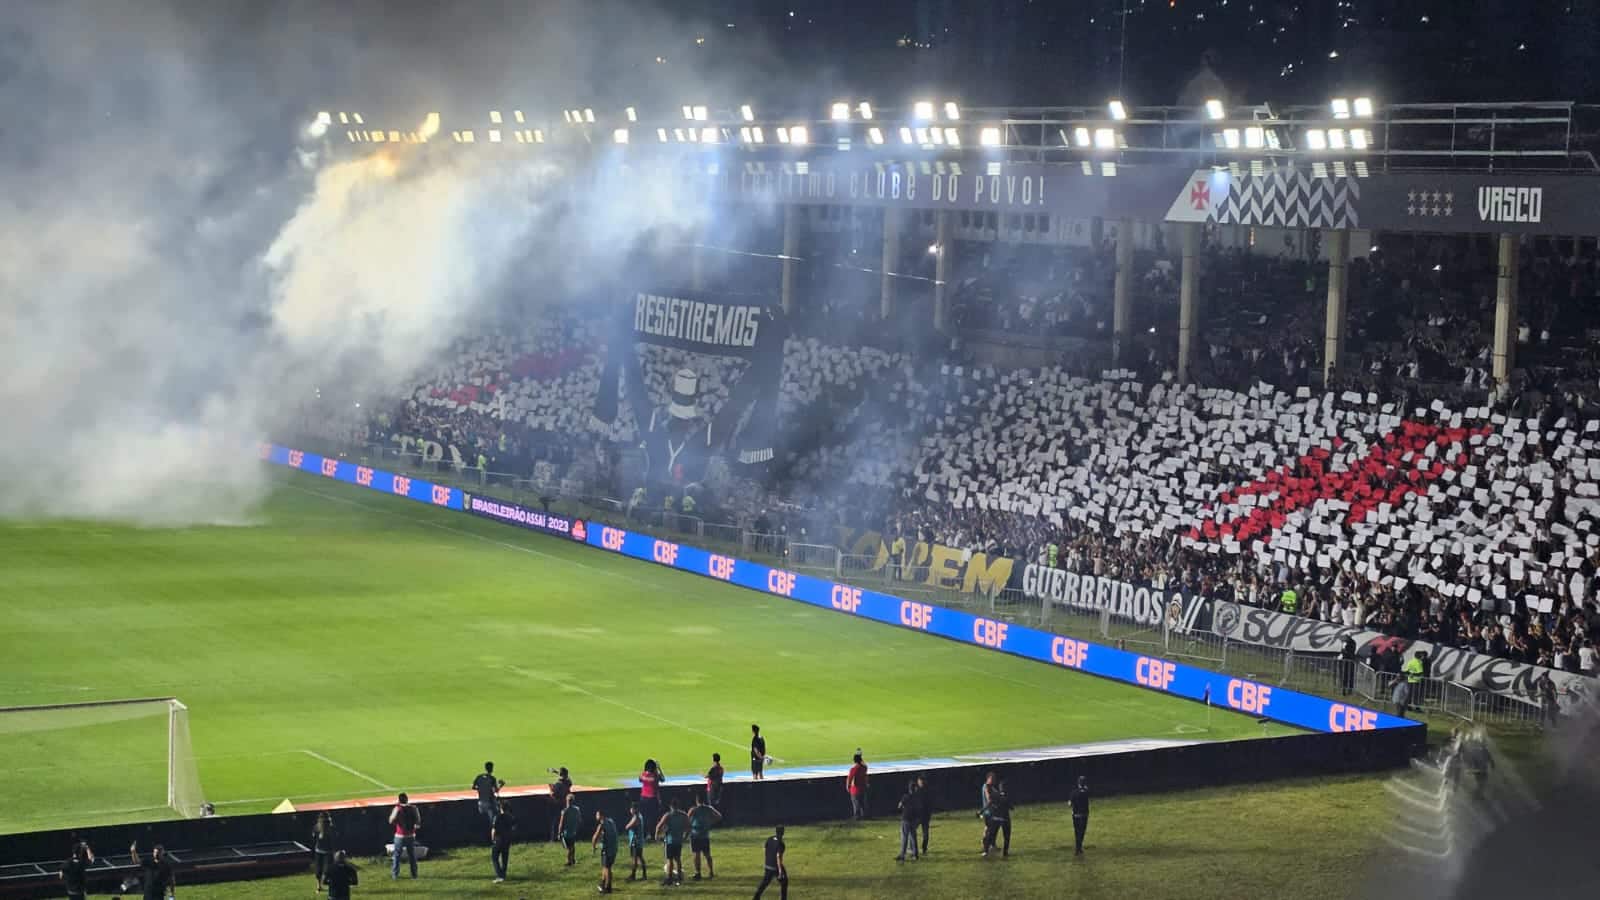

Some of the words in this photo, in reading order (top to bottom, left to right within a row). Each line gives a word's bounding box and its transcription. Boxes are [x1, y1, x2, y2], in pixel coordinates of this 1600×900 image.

[932, 173, 959, 203] DO
[973, 174, 1044, 206] POVO!
[1478, 187, 1542, 223] VASCO
[634, 292, 761, 347] RESISTIREMOS
[289, 449, 304, 469] CBF
[322, 457, 339, 478] CBF
[356, 466, 374, 487] CBF
[393, 475, 411, 497] CBF
[432, 485, 452, 507] CBF
[471, 498, 526, 523] BRASILEIRÃO
[548, 517, 569, 533] 2023
[834, 527, 1014, 597] OVEM
[1022, 563, 1164, 625] GUERREIROS
[602, 527, 625, 551] CBF
[653, 540, 679, 566] CBF
[708, 554, 736, 581] CBF
[768, 569, 796, 597] CBF
[831, 584, 863, 614] CBF
[900, 601, 933, 630] CBF
[973, 618, 1009, 649] CBF
[1051, 637, 1089, 669] CBF
[1135, 656, 1176, 690] CBF
[1227, 679, 1272, 714] CBF
[1328, 703, 1378, 732] CBF
